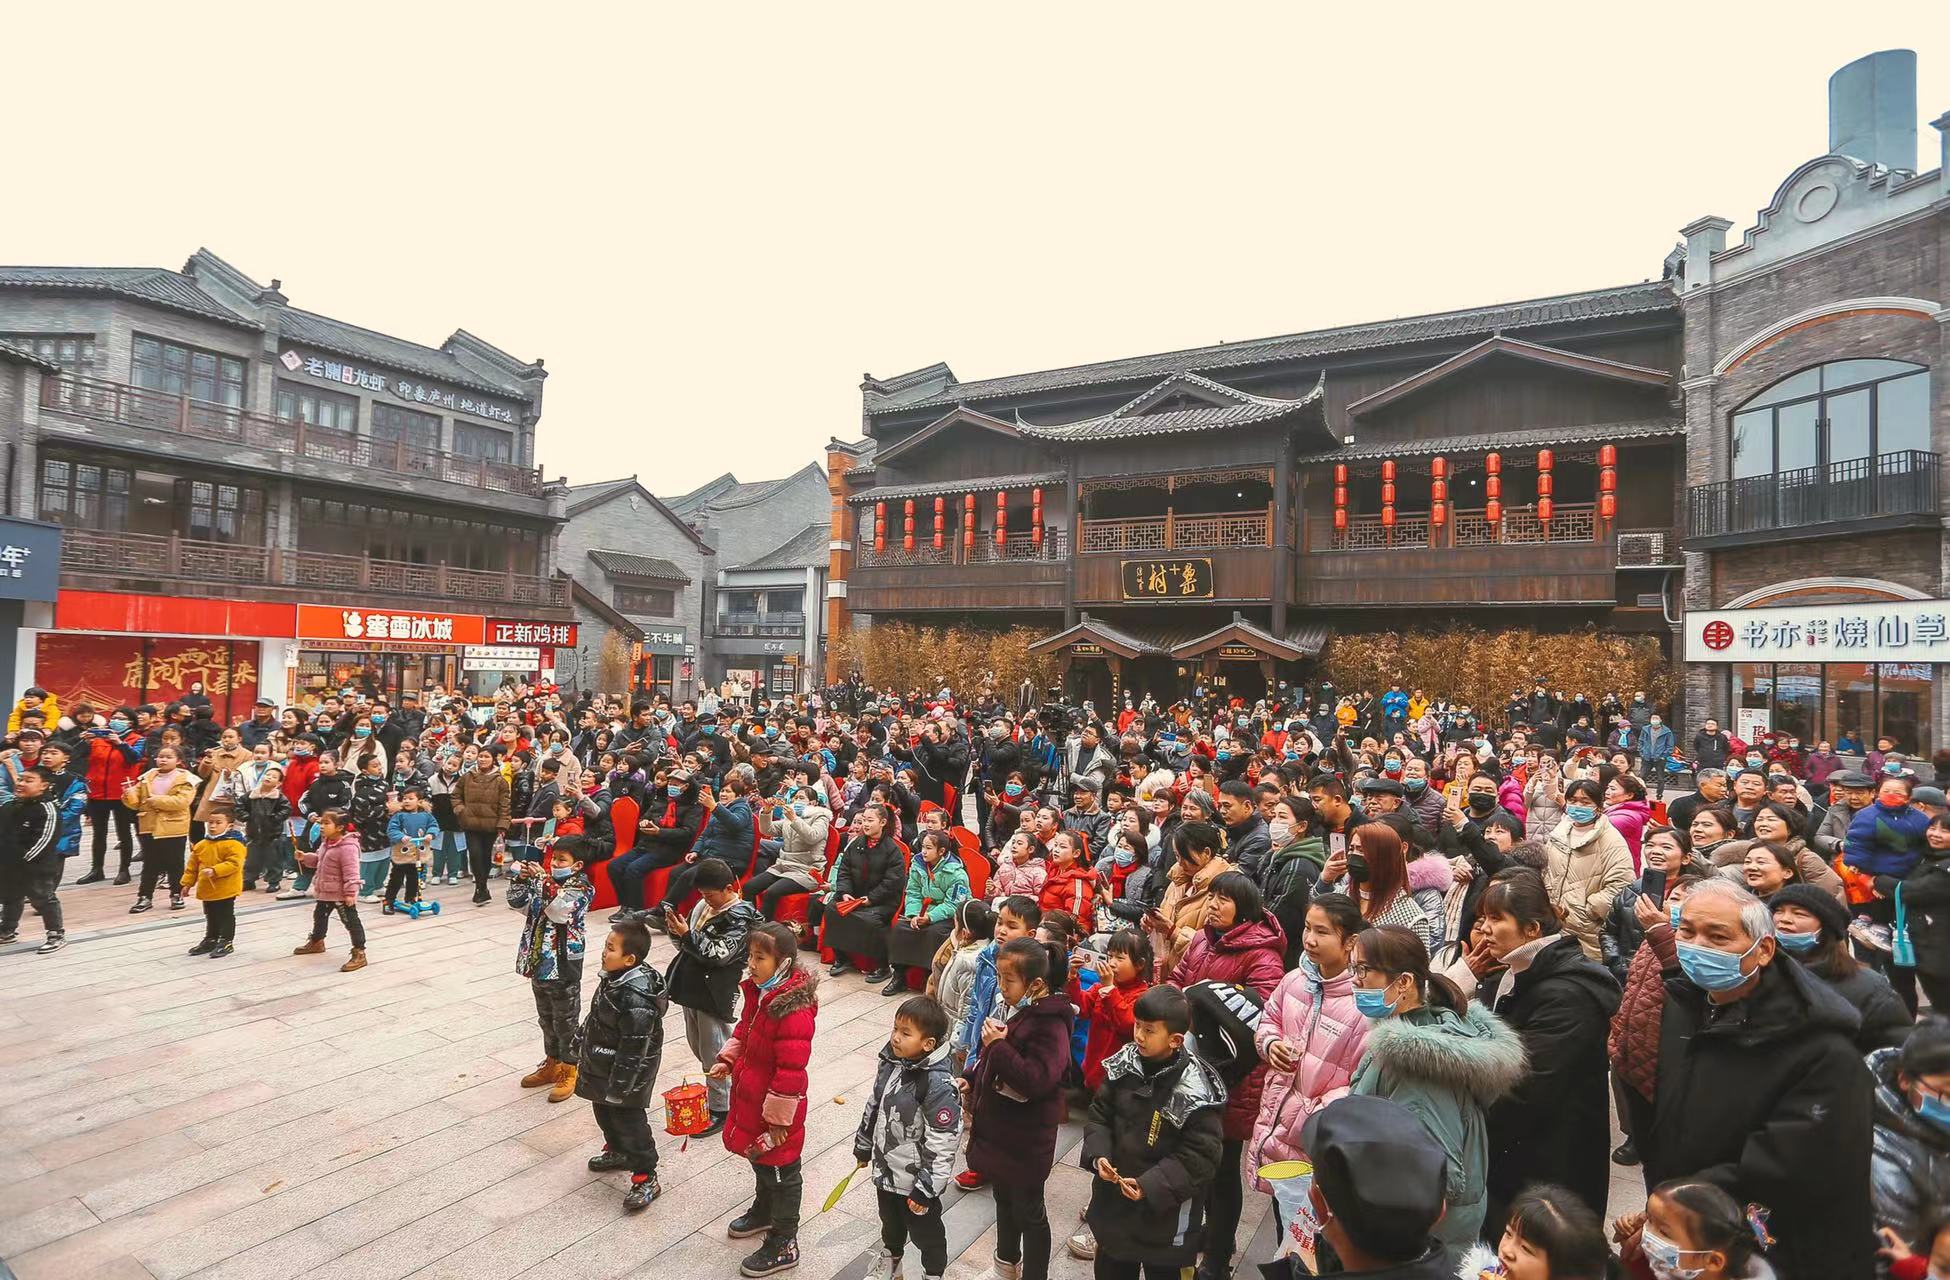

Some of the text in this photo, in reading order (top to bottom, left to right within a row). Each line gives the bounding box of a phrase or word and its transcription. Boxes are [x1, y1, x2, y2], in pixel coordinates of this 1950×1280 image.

[366, 614, 453, 641] 蜜雪冰城
[496, 623, 570, 644] 正新鸡排
